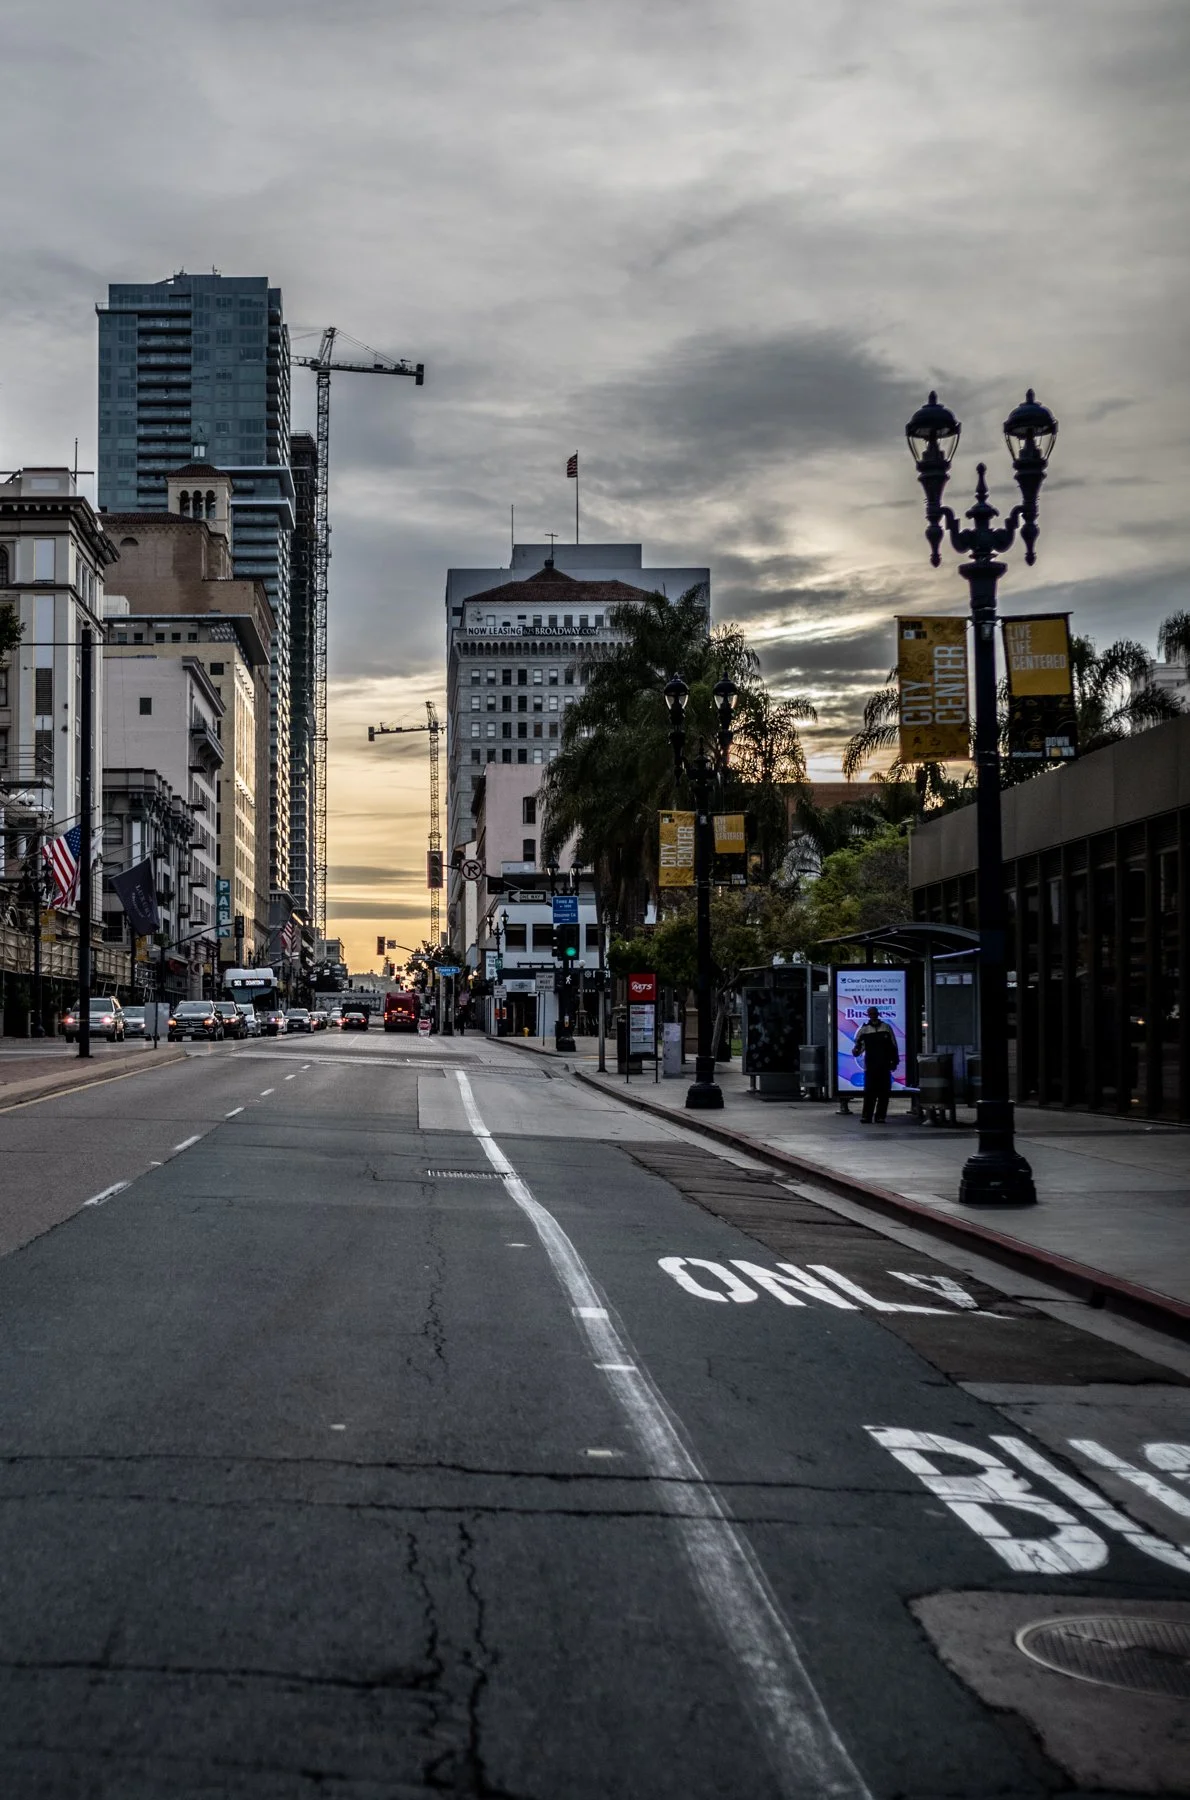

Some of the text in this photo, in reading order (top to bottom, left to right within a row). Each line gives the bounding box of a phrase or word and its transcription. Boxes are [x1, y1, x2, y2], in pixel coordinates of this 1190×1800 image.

[468, 627, 486, 635] NOW
[489, 627, 522, 635] LEASING
[1007, 623, 1032, 640] LIVE
[1008, 640, 1032, 655] LIFE
[1012, 654, 1067, 670] CENTERED
[934, 645, 966, 724] CENTER
[902, 680, 933, 725] CITY
[715, 831, 744, 840] CENTERED
[677, 826, 694, 867] CENTER
[661, 843, 676, 867] CITY
[218, 880, 229, 936] PARK
[632, 983, 653, 991] MTS
[853, 995, 896, 1005] Women
[847, 1008, 897, 1019] Busess
